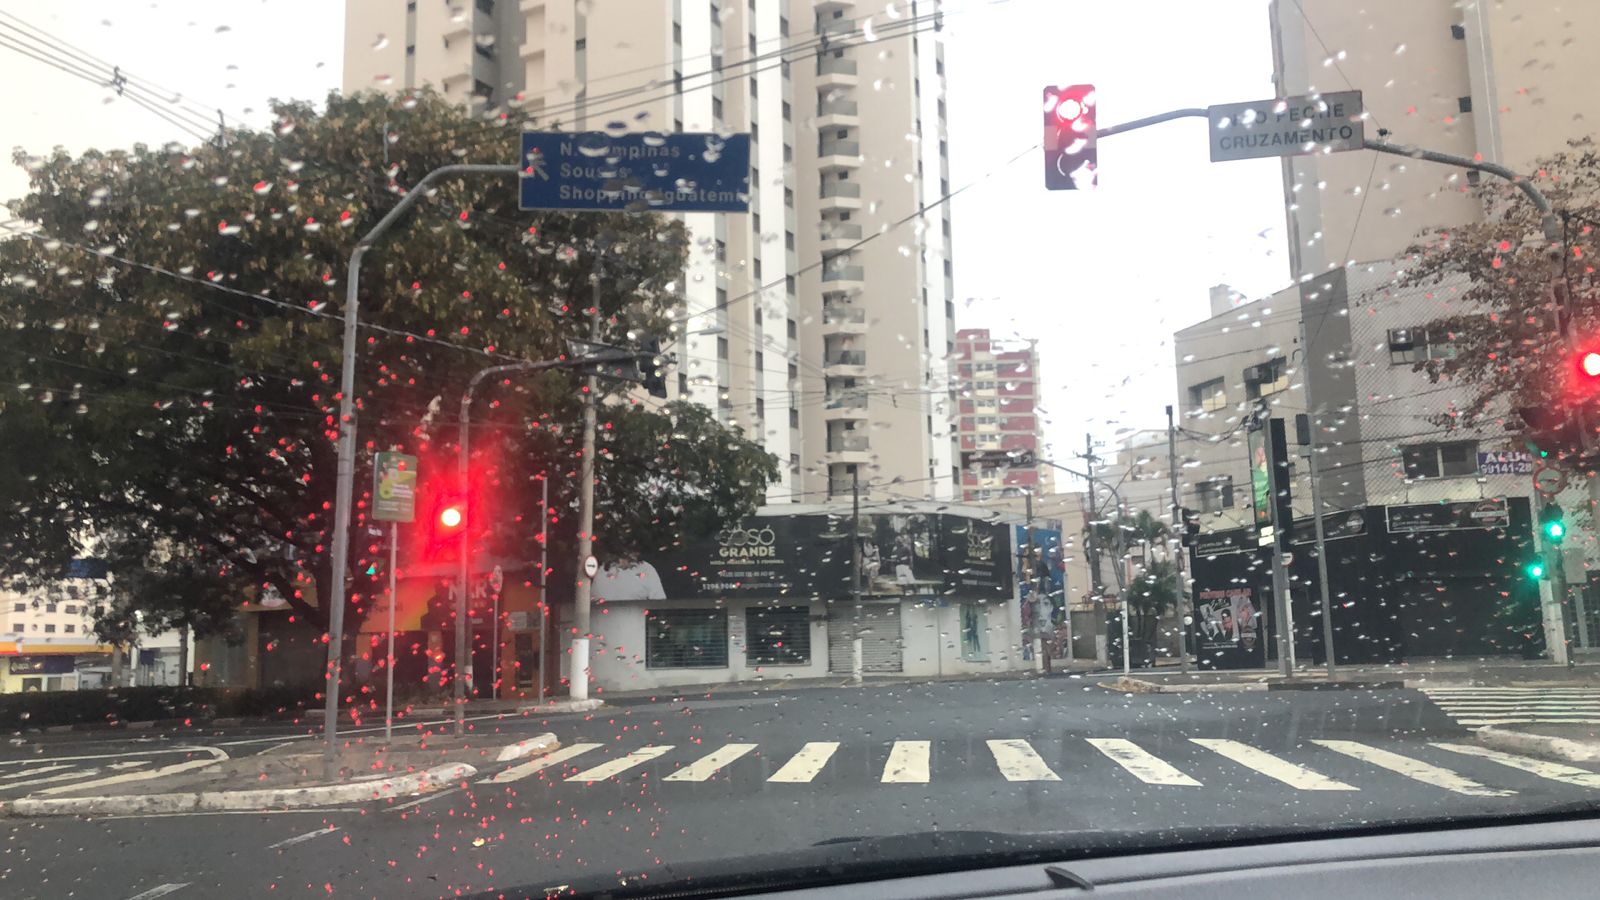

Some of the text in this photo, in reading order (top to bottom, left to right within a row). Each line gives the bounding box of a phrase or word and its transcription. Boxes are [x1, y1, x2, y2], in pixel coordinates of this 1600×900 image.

[1219, 125, 1353, 150] CRUZAMENTO
[583, 142, 681, 160] mpinas
[560, 162, 629, 178] Sous
[658, 184, 742, 204] guatemi
[719, 546, 776, 558] GRANDE
